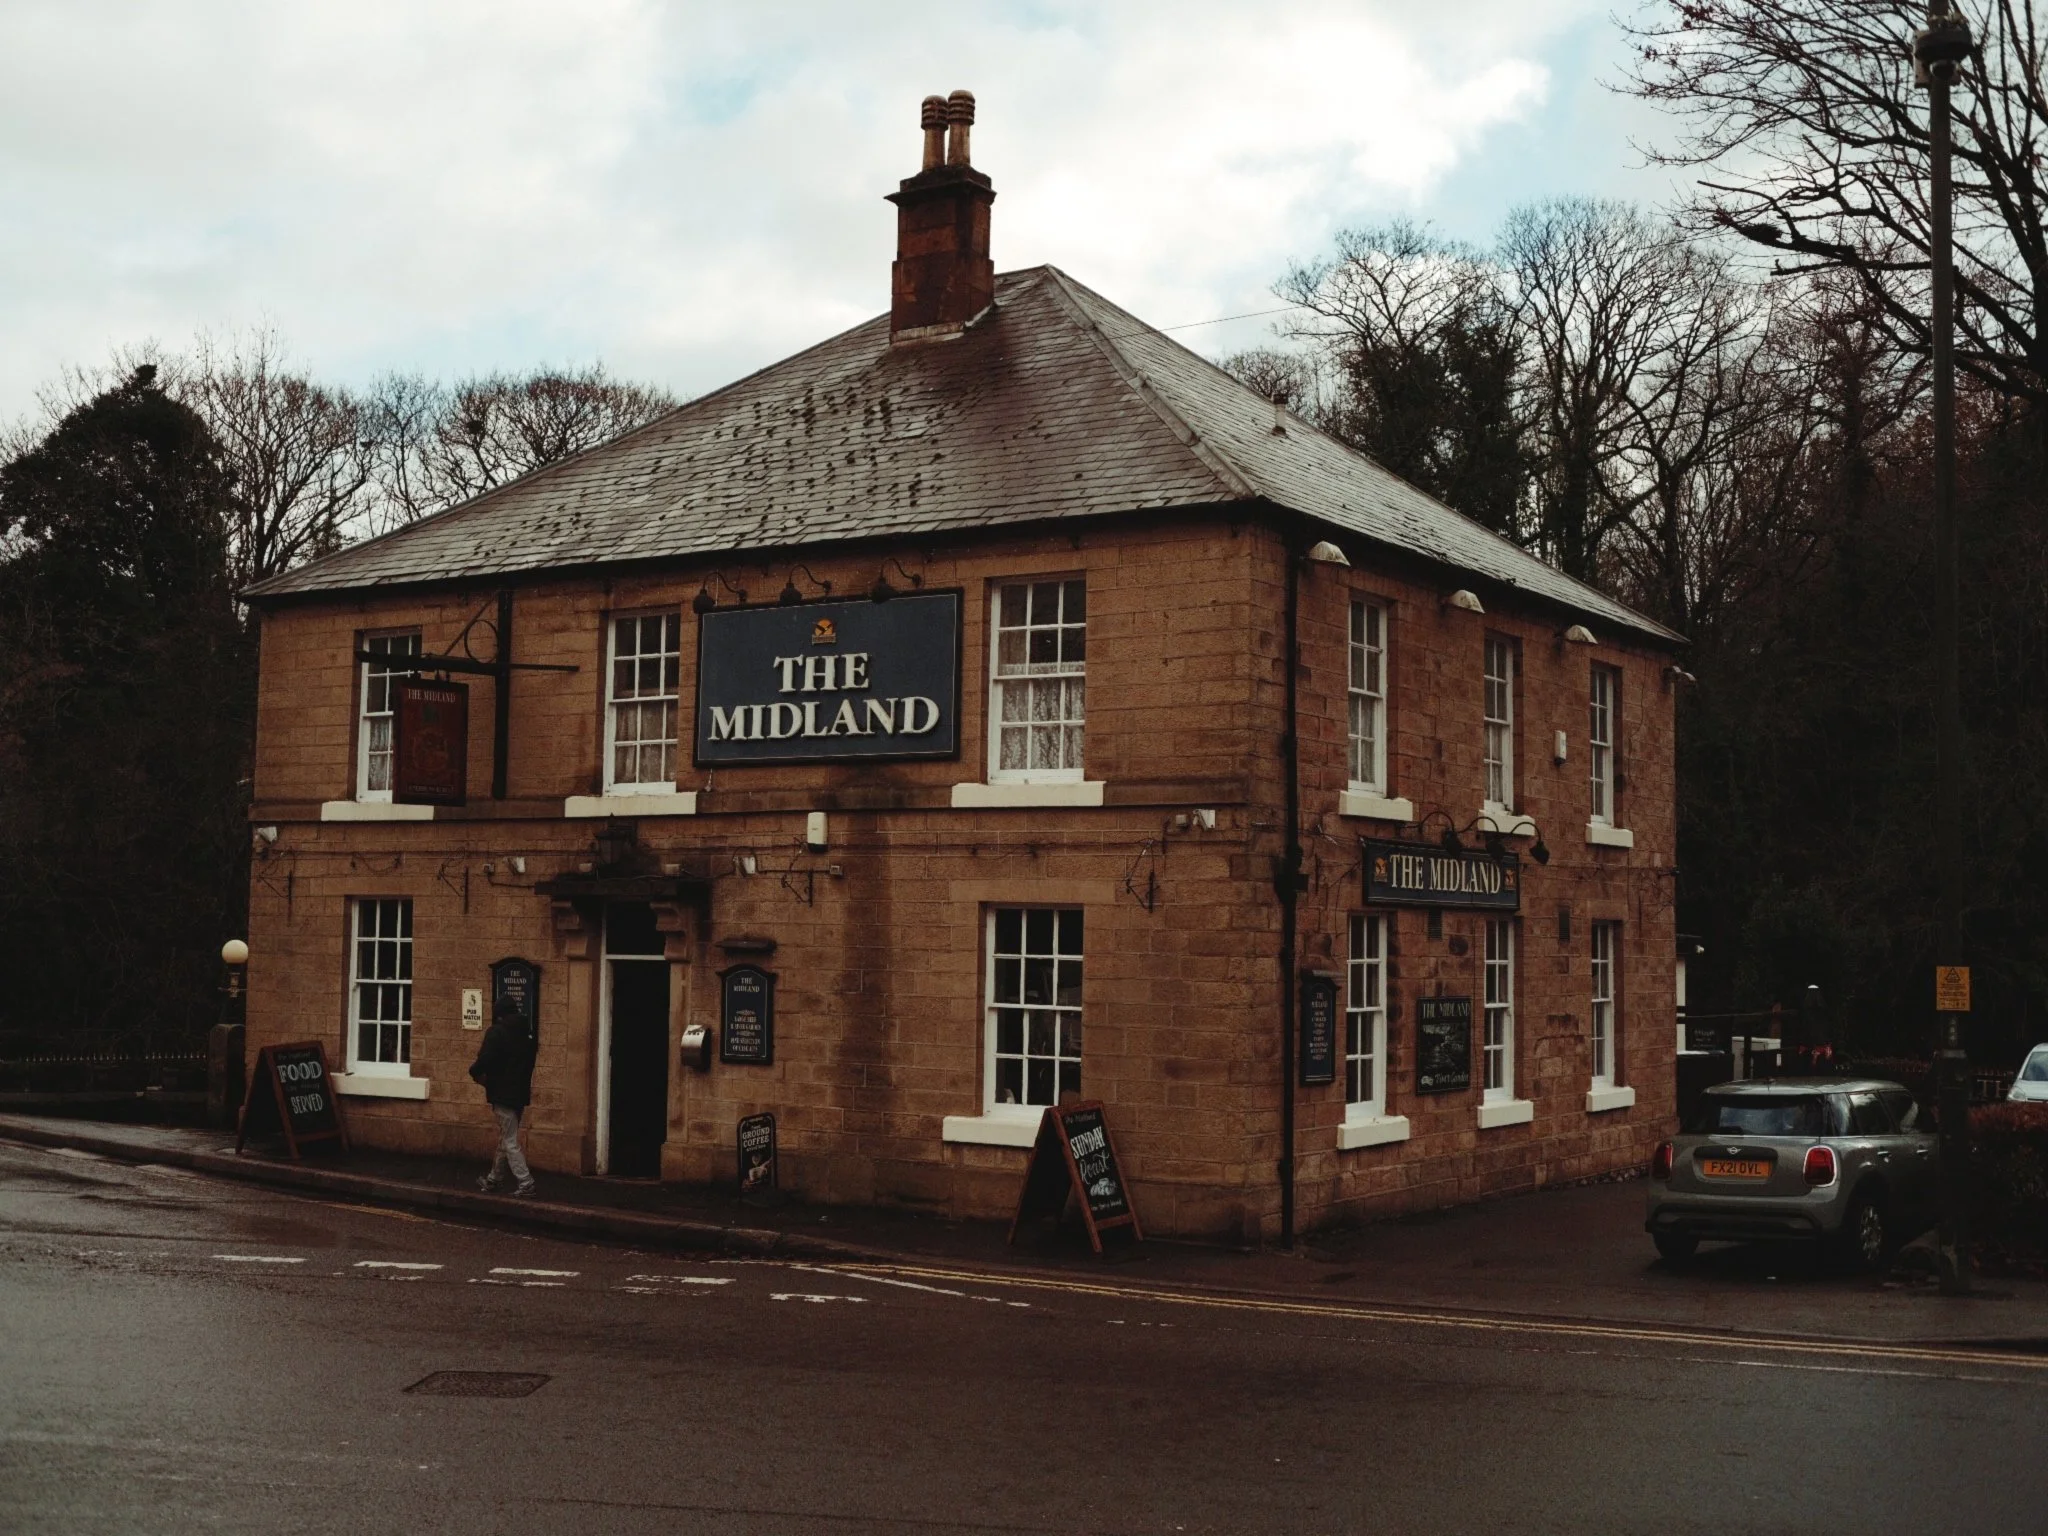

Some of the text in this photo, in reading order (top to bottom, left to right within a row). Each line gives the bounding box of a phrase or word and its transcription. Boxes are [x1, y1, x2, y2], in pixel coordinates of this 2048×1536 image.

[773, 652, 870, 693] THE
[407, 688, 456, 703] THE MIDLAND
[707, 696, 940, 741] MIDLAND
[1390, 855, 1500, 895] THE MIDLAND
[733, 985, 760, 993] MIDLAND
[1423, 1002, 1470, 1018] THE MIDLAND
[277, 1061, 322, 1083] FOOD
[290, 1093, 323, 1114] SERVED
[742, 1127, 770, 1140] GROUND
[743, 1135, 770, 1149] COFFEE
[1070, 1125, 1106, 1160] SUNDAY
[1080, 1149, 1110, 1185] Roast
[1711, 1161, 1762, 1175] FX21 OVL
